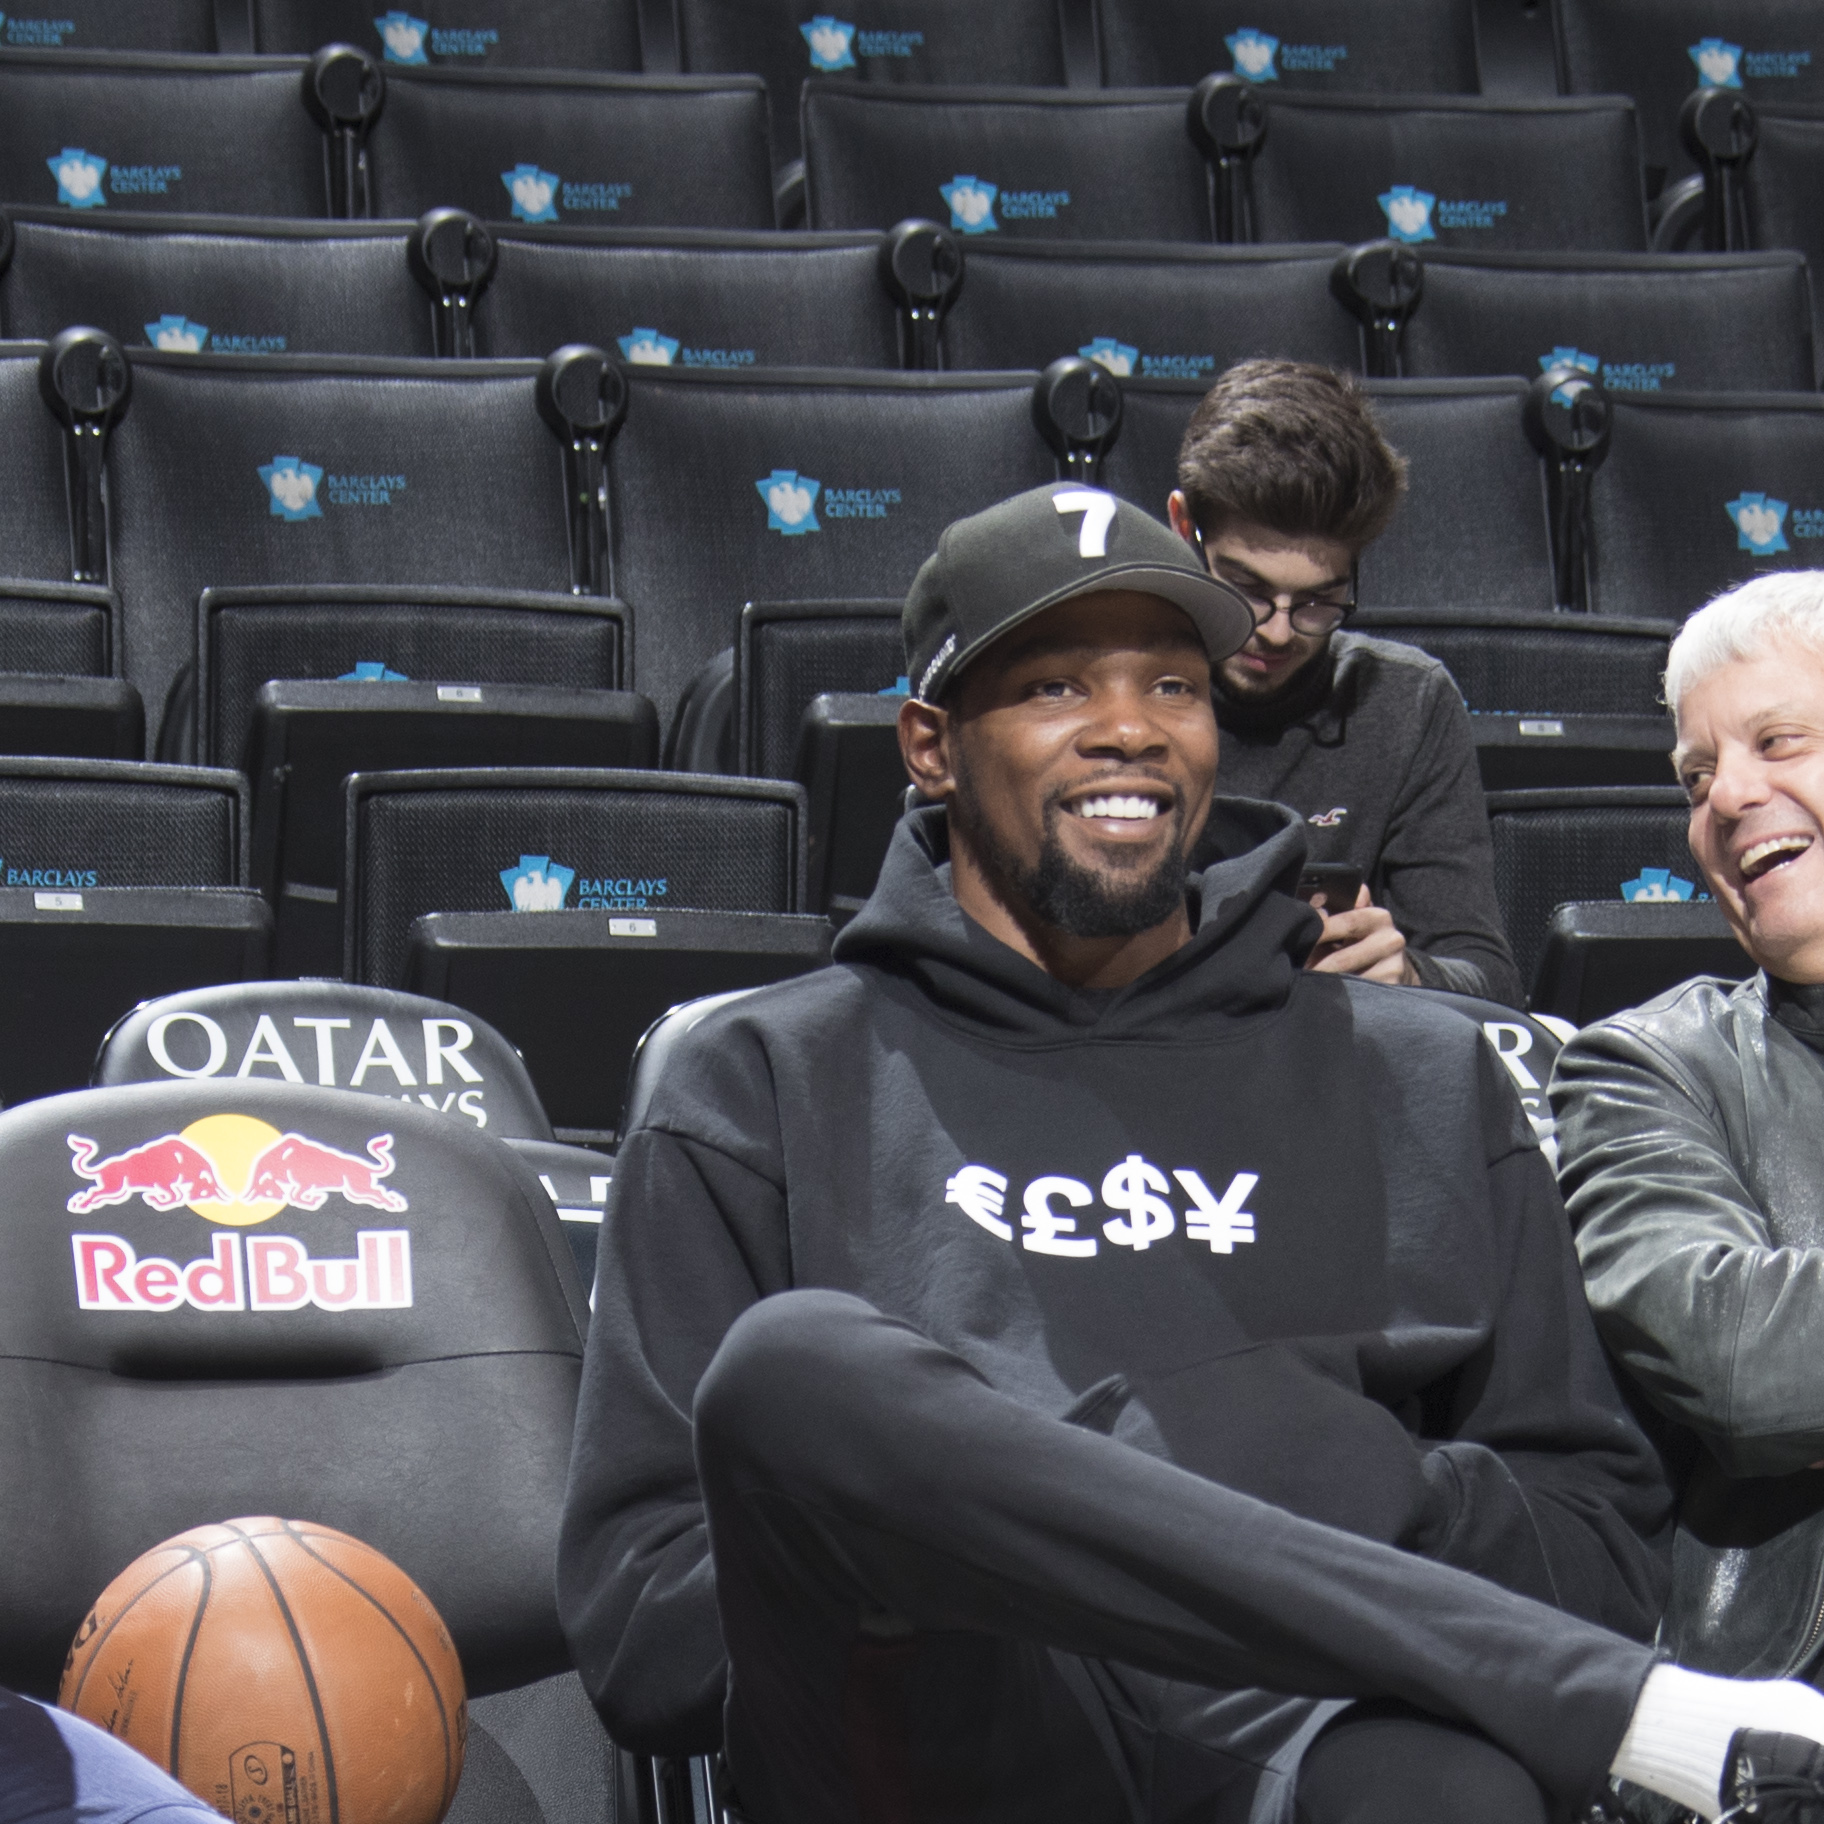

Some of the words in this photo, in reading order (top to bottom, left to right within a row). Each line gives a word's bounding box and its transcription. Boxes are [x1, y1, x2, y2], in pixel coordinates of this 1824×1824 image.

[328, 474, 407, 491] BARCLAYS
[328, 489, 390, 505] CENTER
[825, 488, 901, 503] BARCLAYS
[825, 502, 887, 518] CENTER
[1052, 491, 1116, 558] 7
[7, 869, 97, 887] BARCLAYS
[579, 878, 666, 896] BARCLAYS
[147, 1012, 484, 1087] QATAR
[76, 1235, 242, 1307] Red
[250, 1234, 408, 1308] Bull
